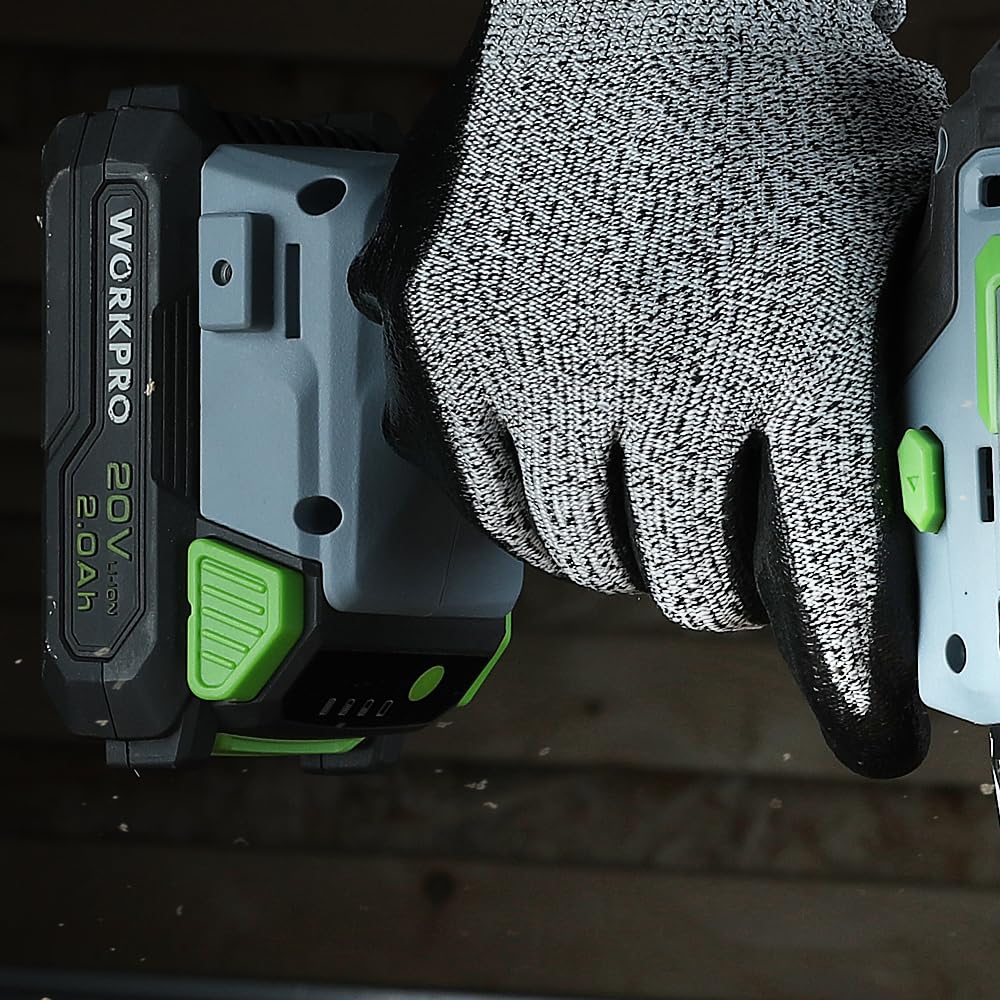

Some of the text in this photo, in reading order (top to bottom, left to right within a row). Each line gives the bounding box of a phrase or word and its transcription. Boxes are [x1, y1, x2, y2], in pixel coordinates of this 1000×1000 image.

[108, 208, 133, 424] WORKPRO
[76, 495, 98, 612] 2.0Ah
[106, 462, 133, 562] 20V
